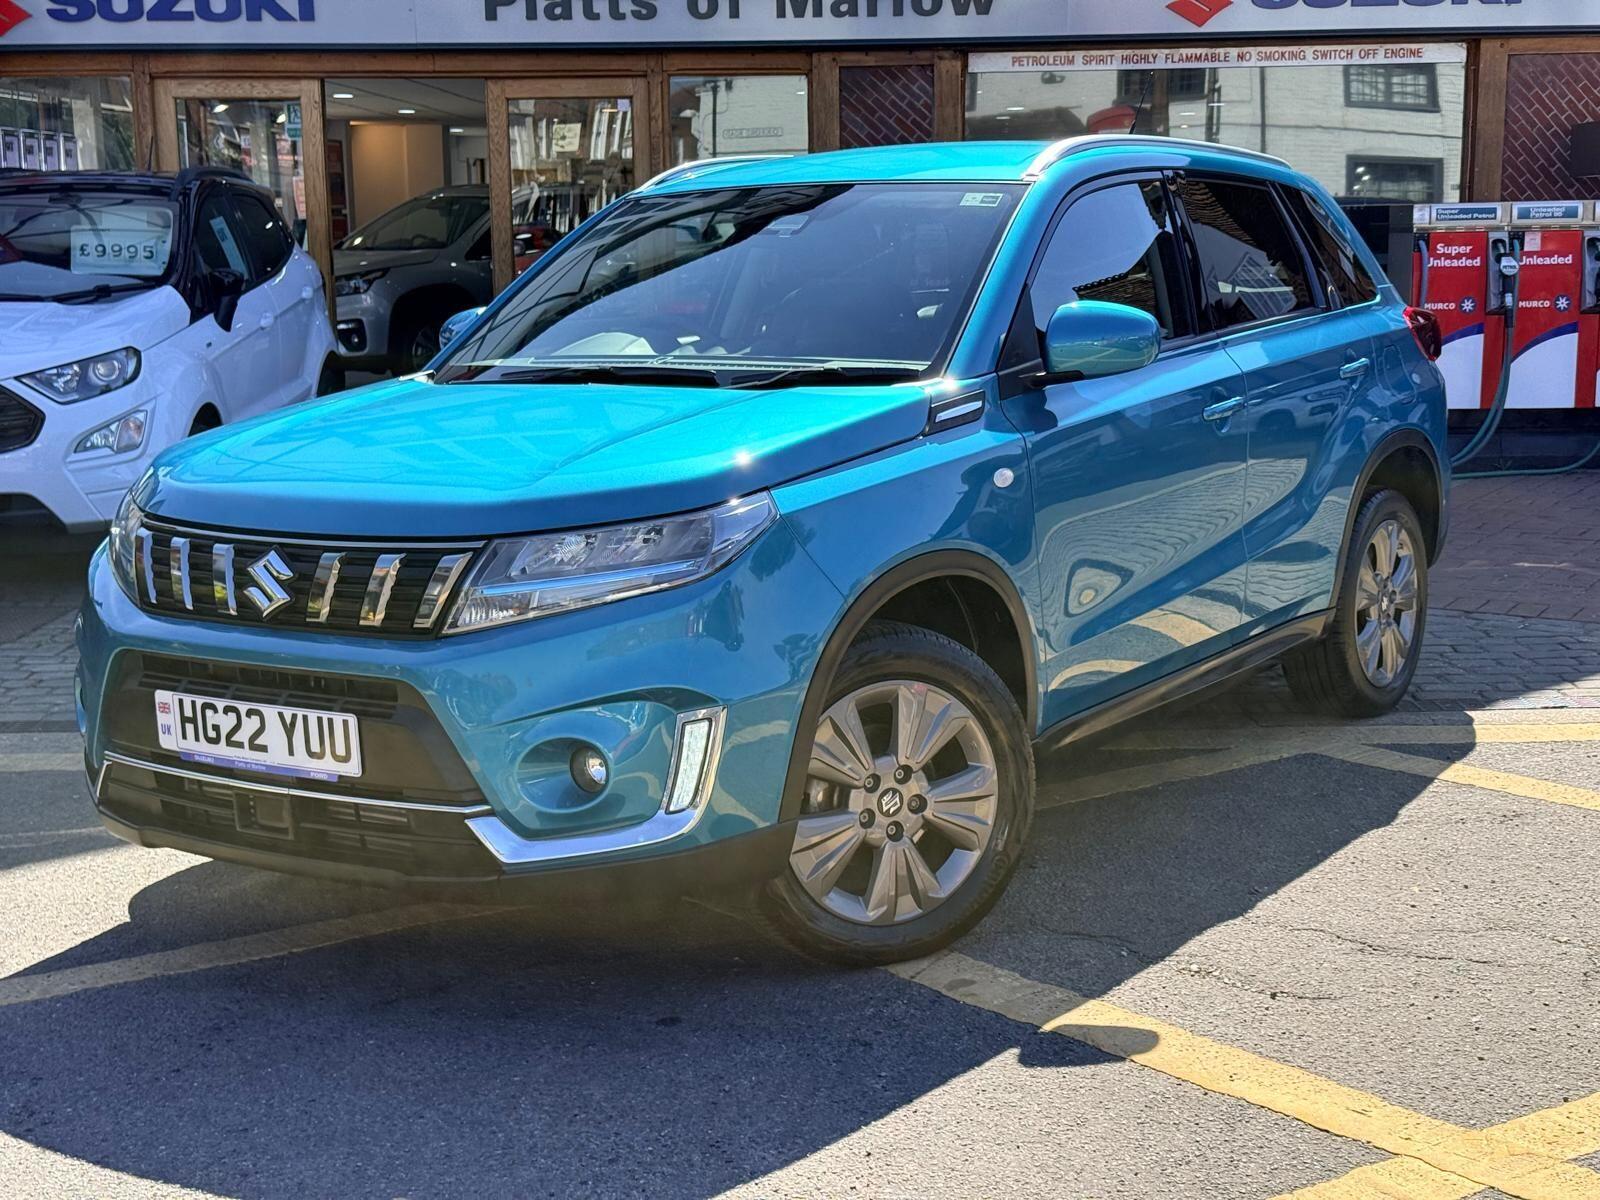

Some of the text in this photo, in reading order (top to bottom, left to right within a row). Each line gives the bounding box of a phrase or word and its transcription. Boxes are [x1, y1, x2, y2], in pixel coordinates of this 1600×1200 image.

[485, 0, 658, 21] Platts
[1011, 47, 1424, 67] PETROLEUM SPIRIT HIGHLY FLAMMABLE NO SMOKING SWITCH OFF ENGINE
[79, 243, 155, 260] £9995
[1436, 243, 1473, 256] Super
[1424, 302, 1456, 310] MURCO
[1519, 300, 1551, 308] MURCO
[161, 723, 172, 736] UK
[178, 697, 352, 764] HG22 YUU
